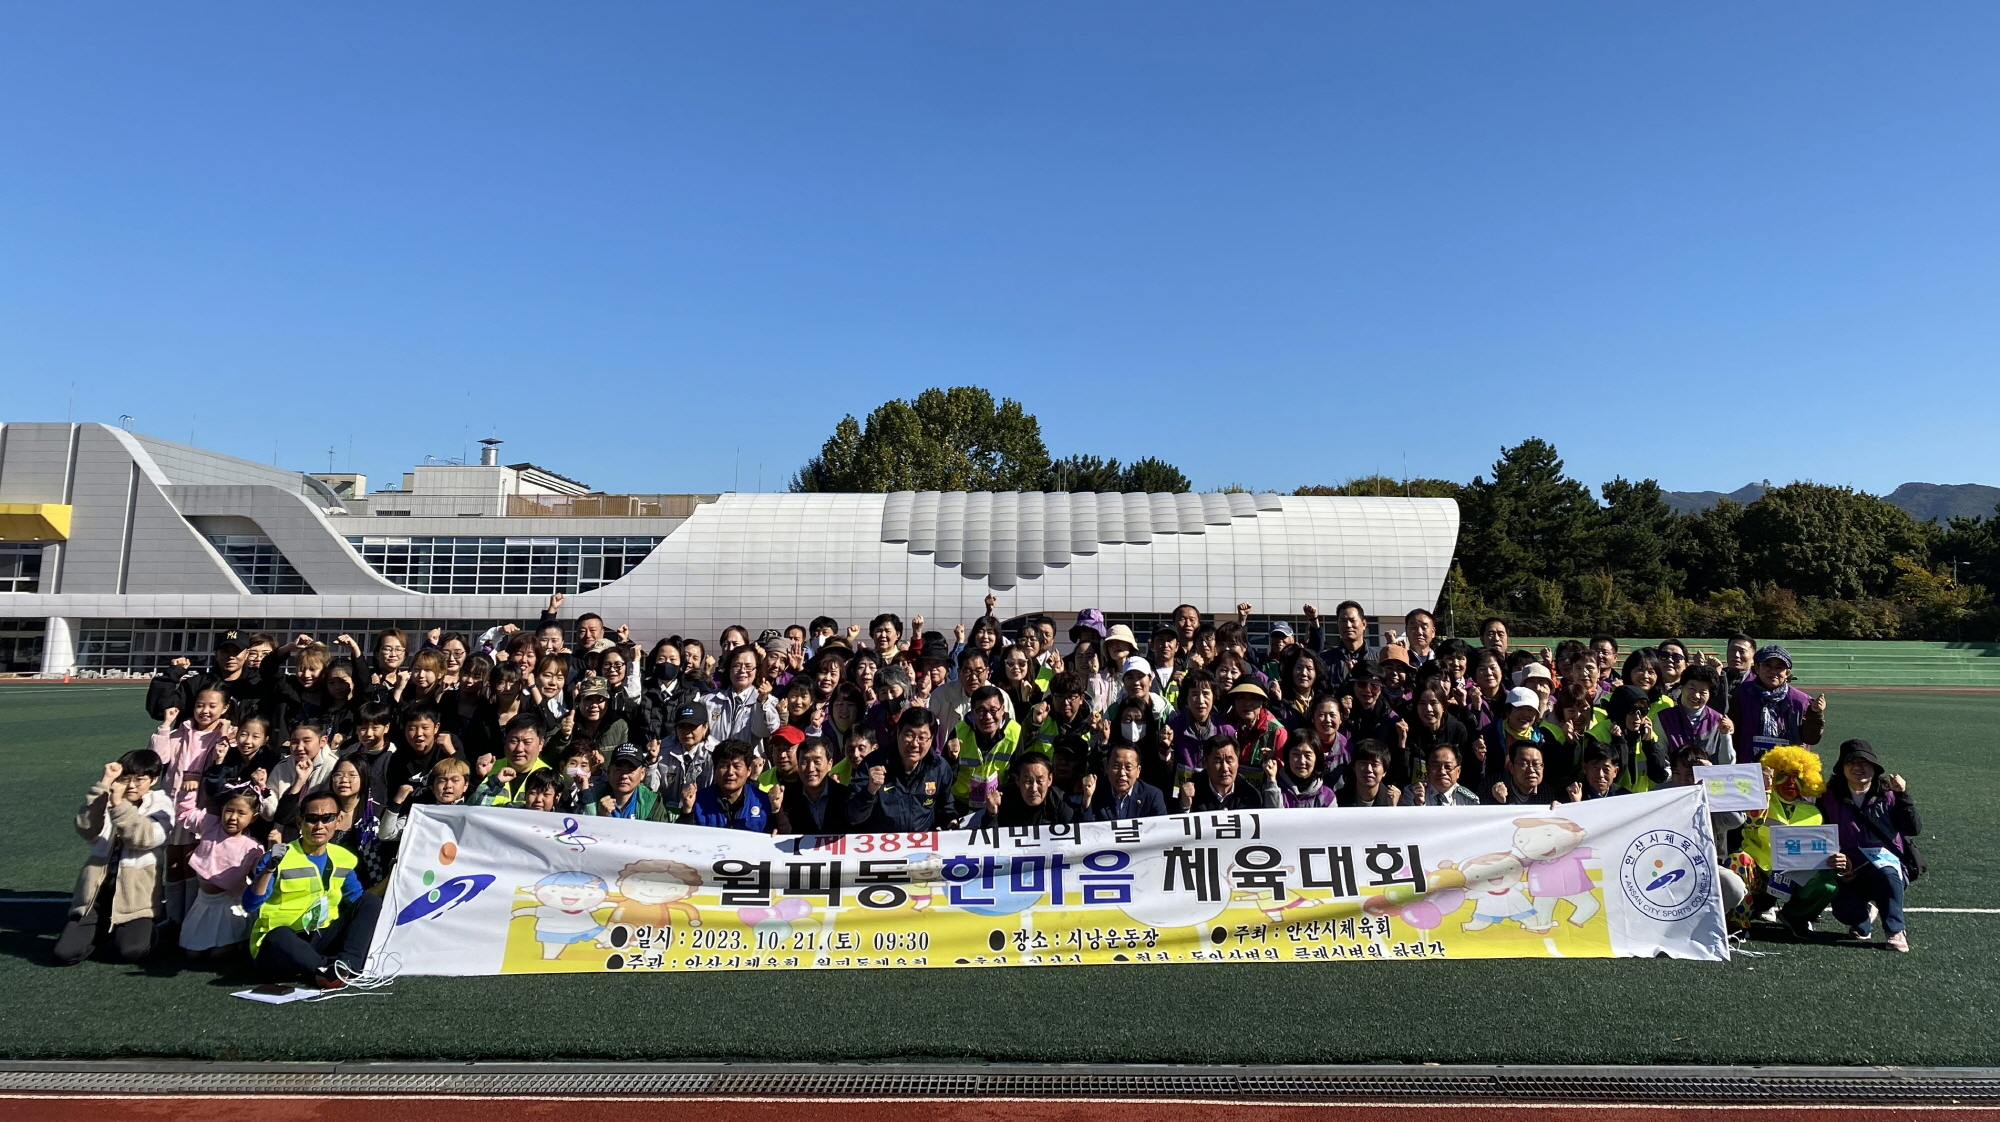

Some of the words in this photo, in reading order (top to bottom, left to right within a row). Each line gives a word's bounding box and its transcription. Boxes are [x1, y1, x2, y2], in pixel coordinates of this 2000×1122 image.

[968, 822, 1081, 848] 시민의
[1111, 819, 1142, 843] 날
[712, 859, 911, 908] 월피동
[940, 850, 1135, 907] 한마음
[1163, 844, 1427, 901] 체육대회
[1626, 880, 1642, 906] ANSAN
[1643, 904, 1661, 916] CITY
[1663, 906, 1692, 917] SPORTS
[875, 930, 930, 951] 09:30
[1067, 927, 1160, 951] 시낭운동장
[1286, 915, 1392, 941] 안산시체육회
